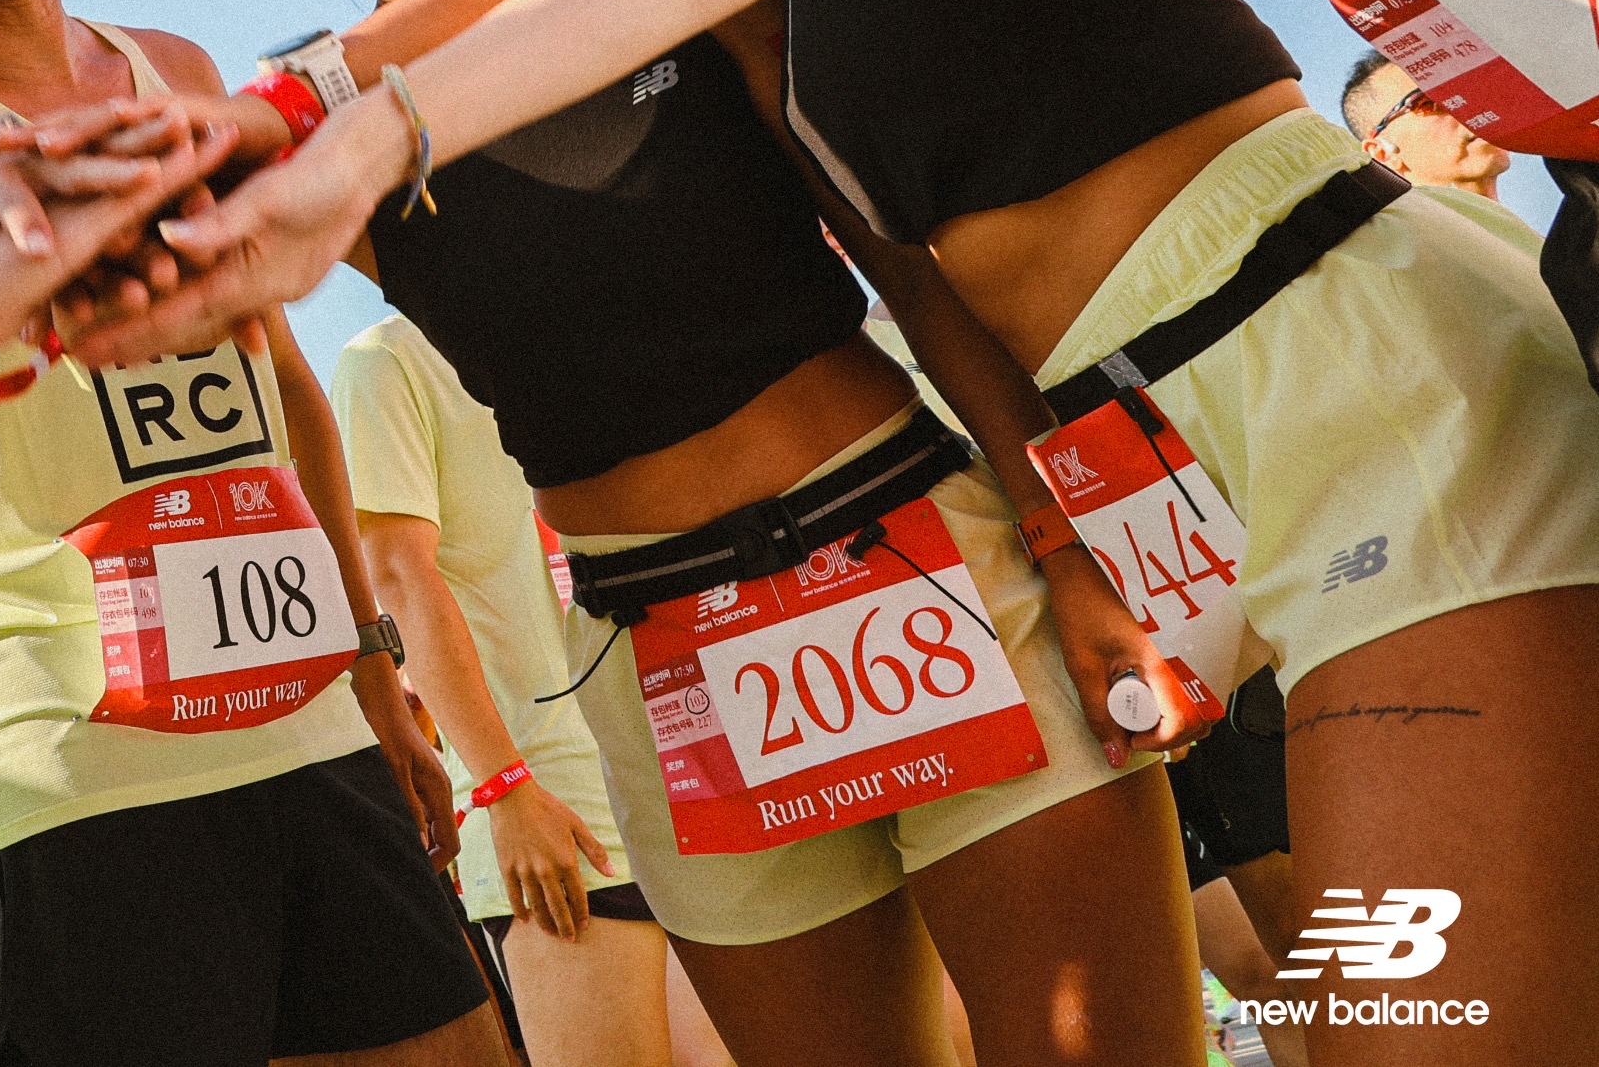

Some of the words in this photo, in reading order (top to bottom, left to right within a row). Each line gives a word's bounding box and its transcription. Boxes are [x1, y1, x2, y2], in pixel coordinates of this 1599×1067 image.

[123, 372, 243, 446] RC
[228, 480, 275, 512] 10K
[148, 520, 167, 531] new
[168, 516, 205, 528] balance
[128, 557, 149, 568] 07:30
[141, 607, 157, 619] 498
[202, 555, 317, 650] 108
[694, 619, 713, 634] new
[714, 604, 759, 627] balance
[673, 663, 695, 679] 07:30
[734, 606, 975, 756] 2068
[171, 693, 217, 721] Run
[225, 687, 271, 721] your
[274, 678, 307, 706] way.
[688, 694, 706, 708] 102
[697, 715, 712, 729] 227
[501, 767, 526, 785] Run
[757, 791, 818, 831] Run
[818, 771, 885, 820] your
[890, 752, 954, 787] way.
